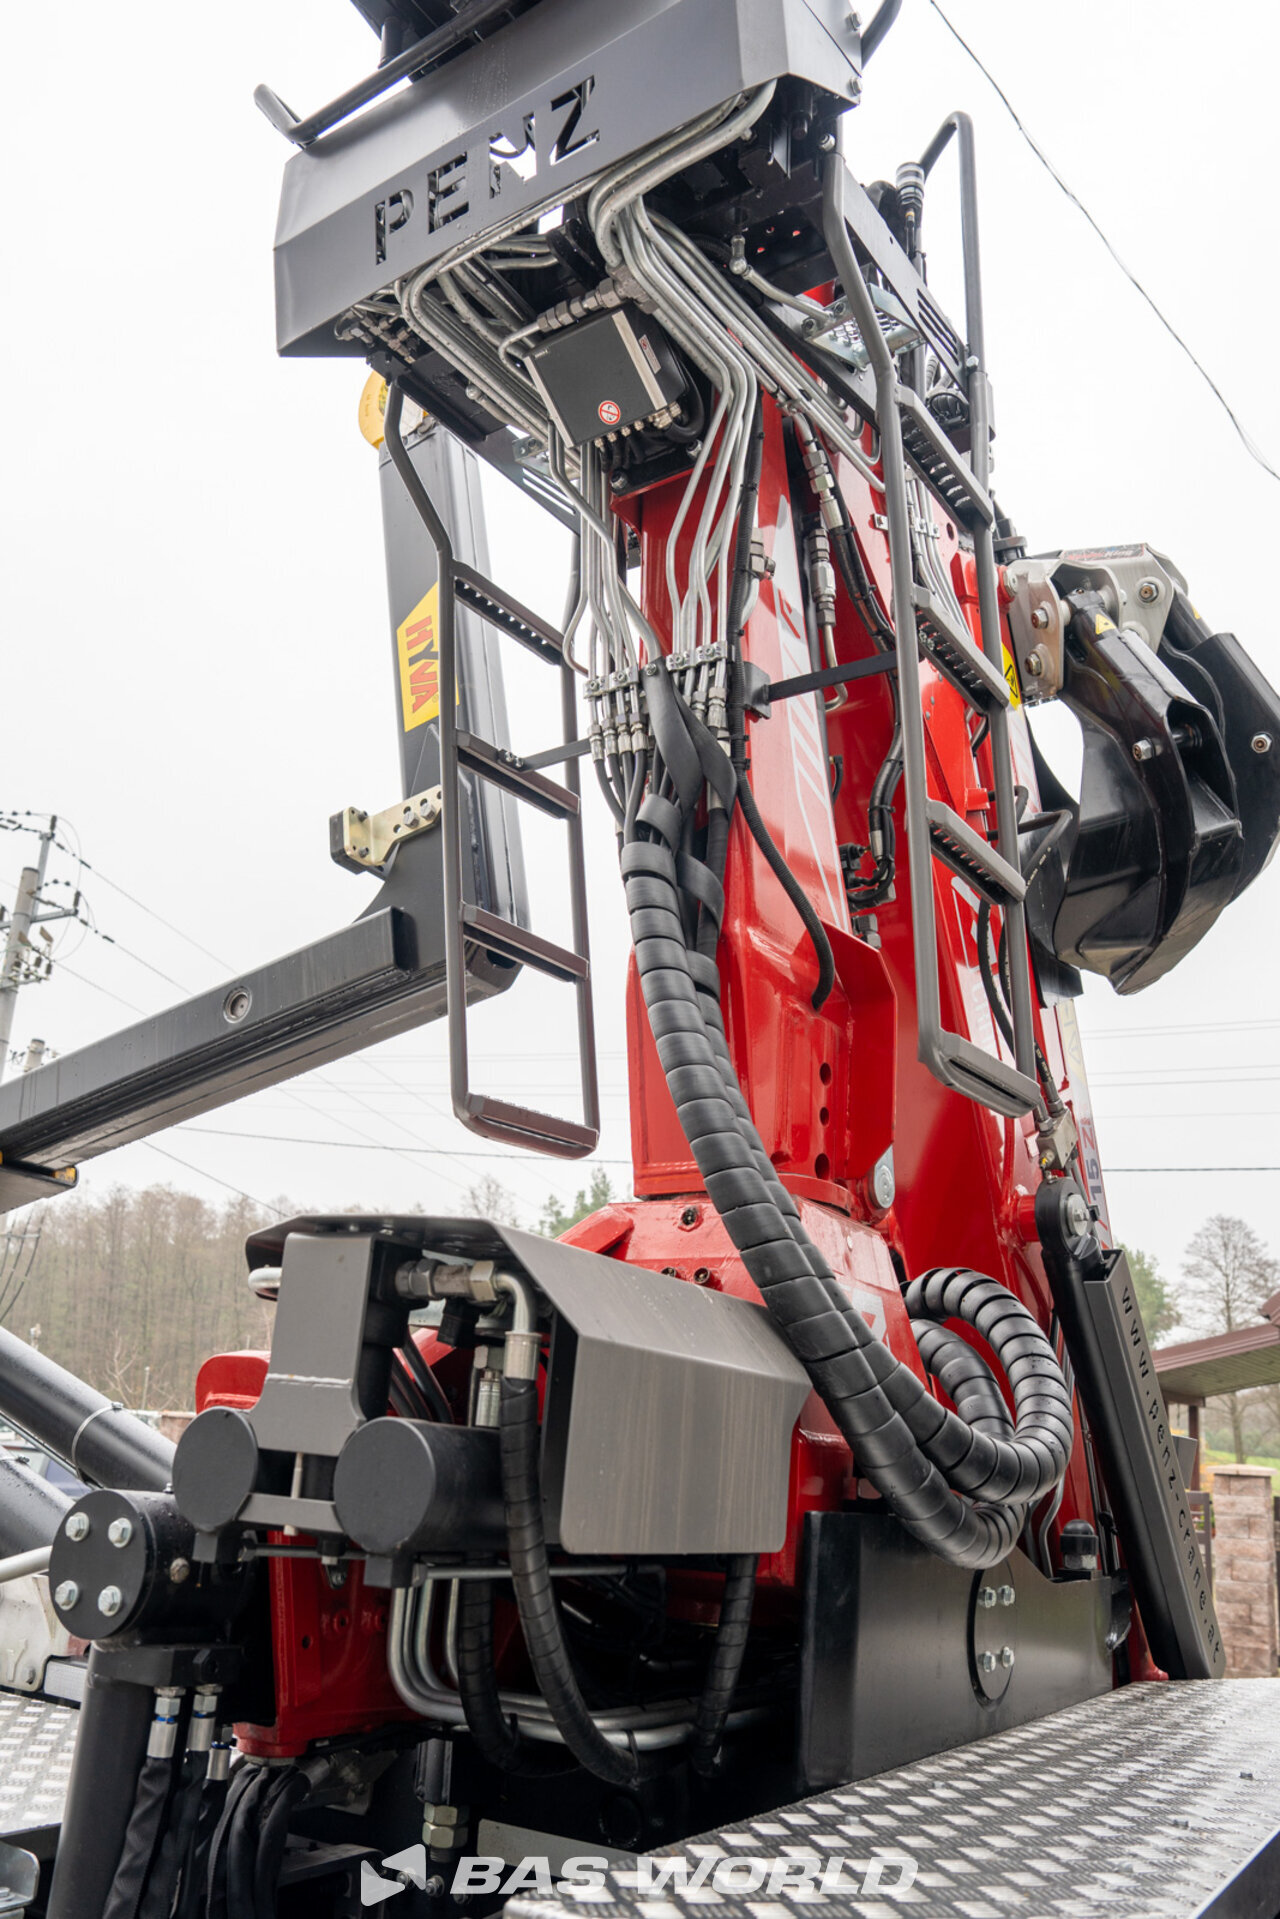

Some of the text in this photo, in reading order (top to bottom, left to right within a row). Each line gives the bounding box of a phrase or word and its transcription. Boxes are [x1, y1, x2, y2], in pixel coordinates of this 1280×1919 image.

[375, 75, 600, 266] PENZ
[405, 615, 439, 713] HYVA
[1122, 1286, 1220, 1663] www.penz-crane.at
